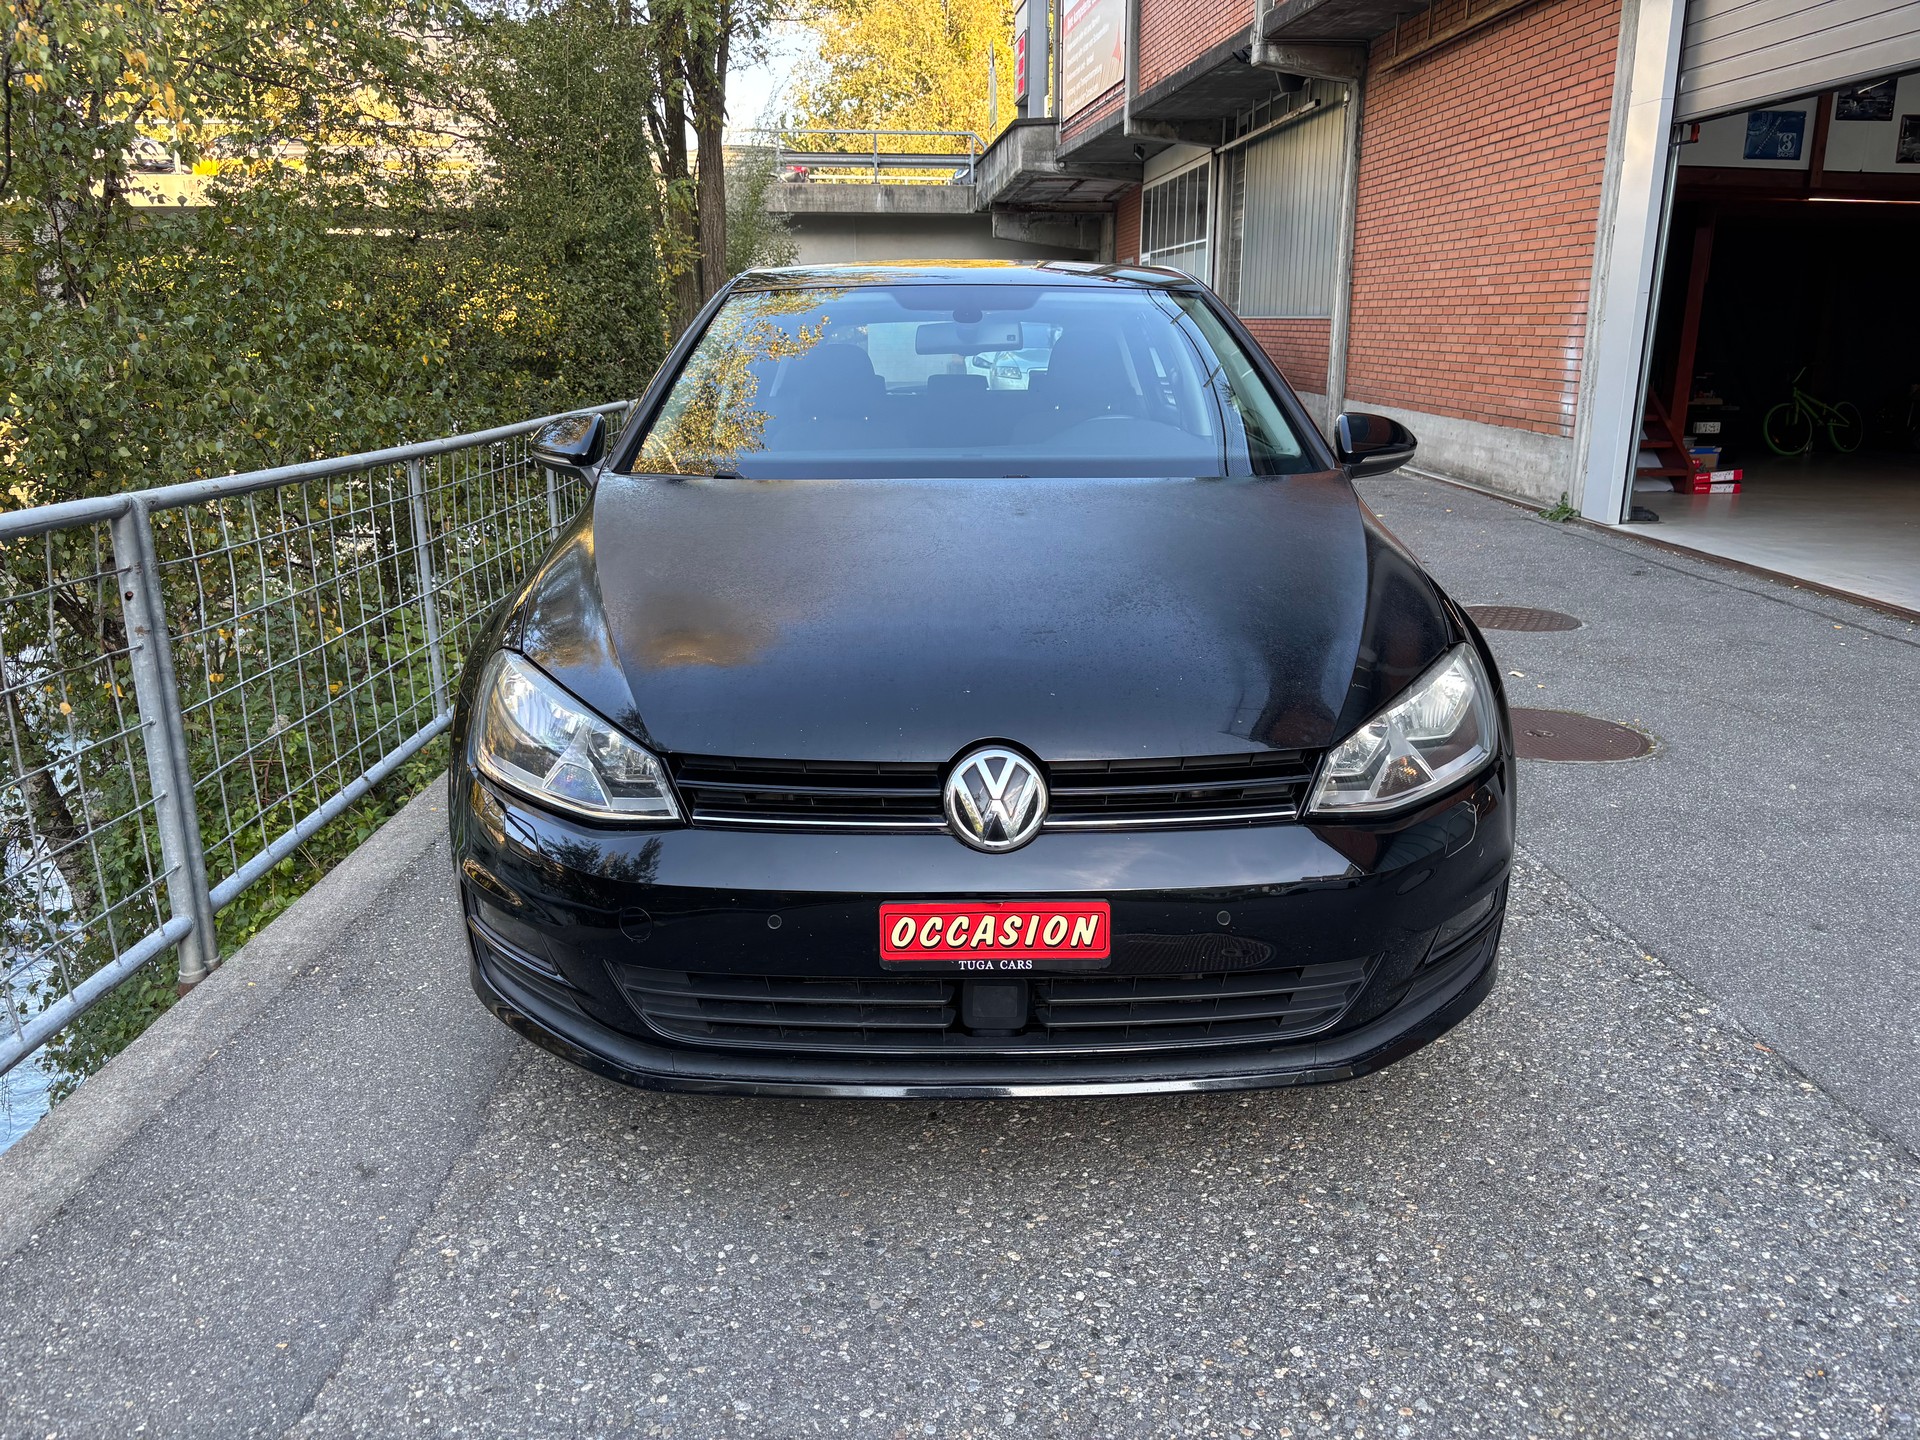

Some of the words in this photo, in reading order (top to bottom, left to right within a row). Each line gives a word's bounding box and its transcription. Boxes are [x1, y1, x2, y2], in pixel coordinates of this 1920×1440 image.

[952, 755, 1040, 844] VW
[890, 914, 1099, 949] OCCASION
[958, 959, 994, 970] TUGA
[1000, 959, 1033, 970] CARS
